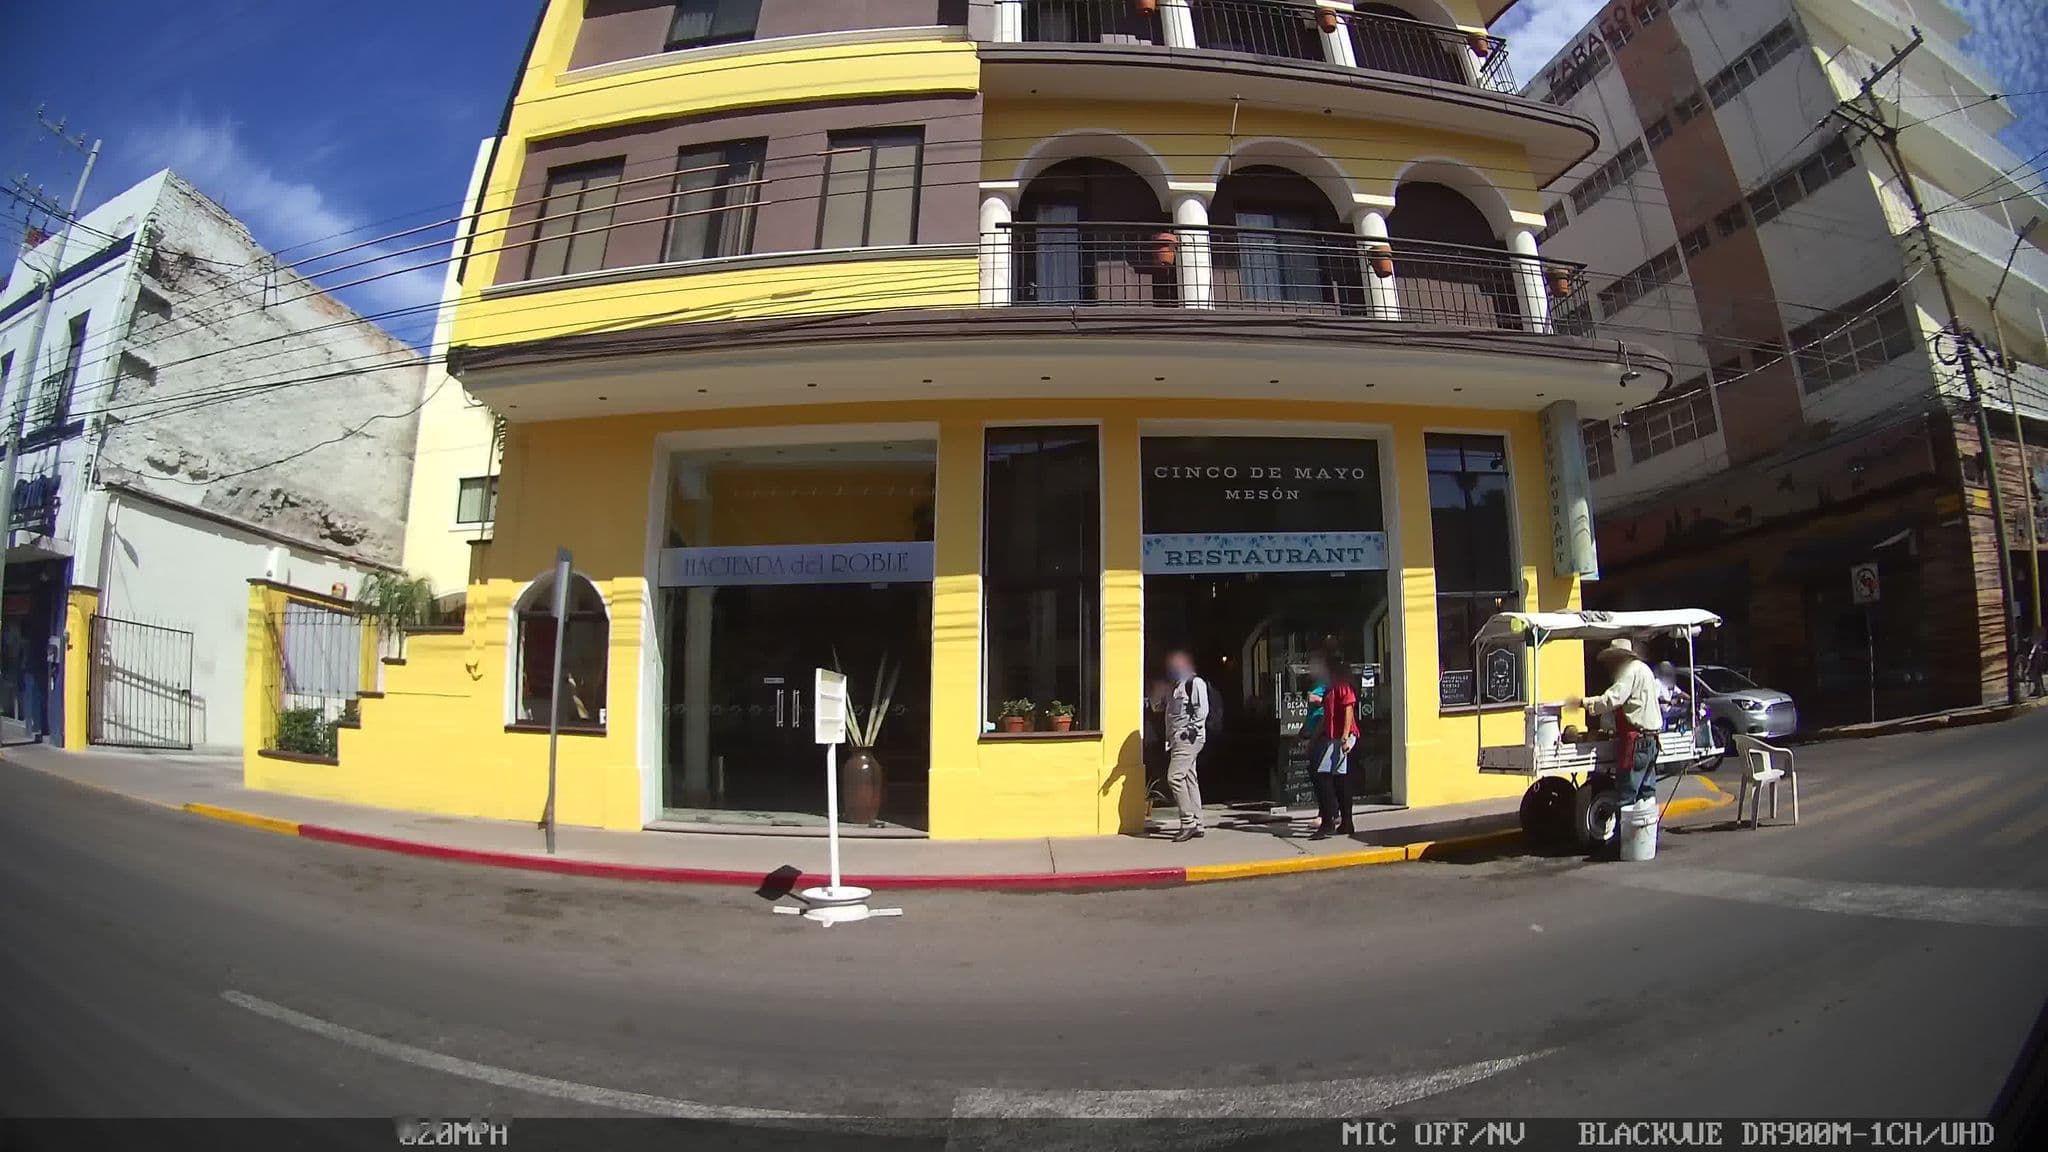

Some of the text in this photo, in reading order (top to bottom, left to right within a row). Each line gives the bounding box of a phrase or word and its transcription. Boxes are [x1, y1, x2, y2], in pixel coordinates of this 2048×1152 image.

[1154, 466, 1366, 480] CINCO DE MAYO
[1225, 487, 1300, 500] MESÓN
[685, 551, 909, 577] HACIENDA del ROBLE
[1164, 547, 1365, 567] RESTAURANT
